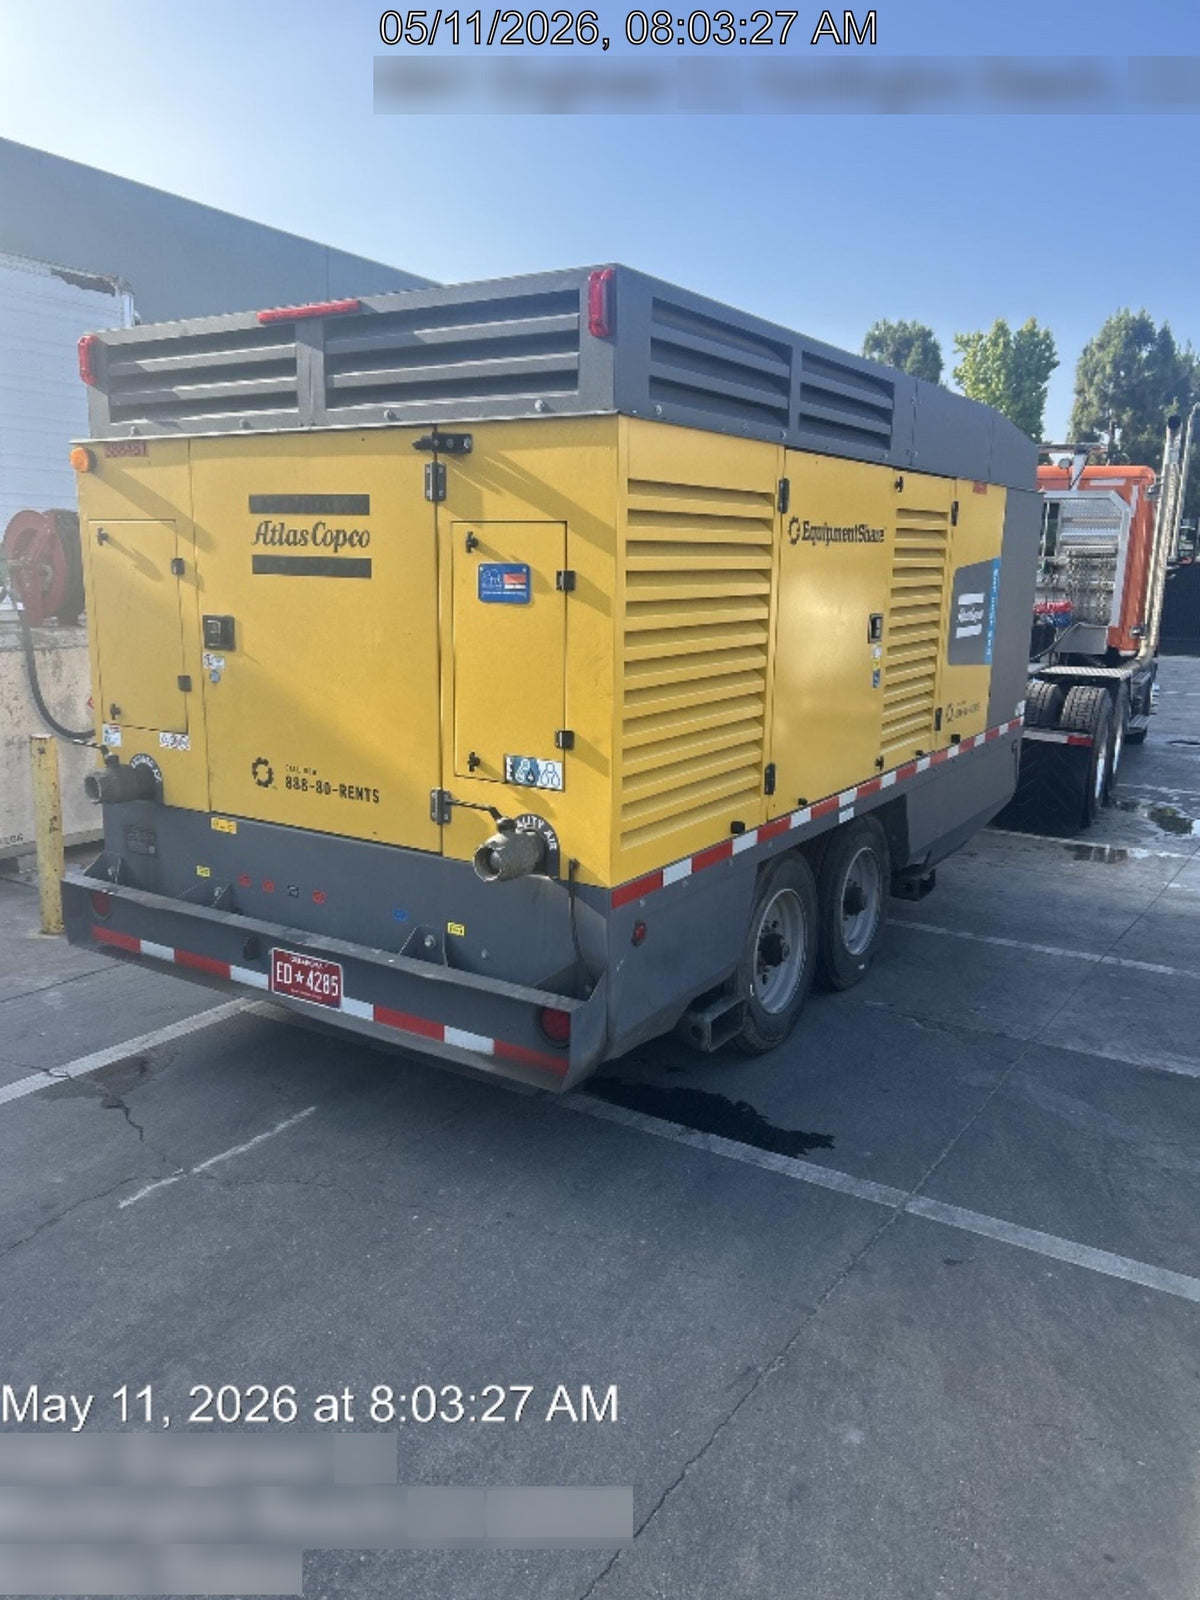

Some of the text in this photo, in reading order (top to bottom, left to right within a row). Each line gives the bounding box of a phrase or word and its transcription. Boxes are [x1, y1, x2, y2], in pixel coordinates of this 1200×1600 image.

[250, 520, 370, 553] Atlas Copco
[285, 775, 380, 804] 888-80-RENTS
[276, 961, 293, 985] ED
